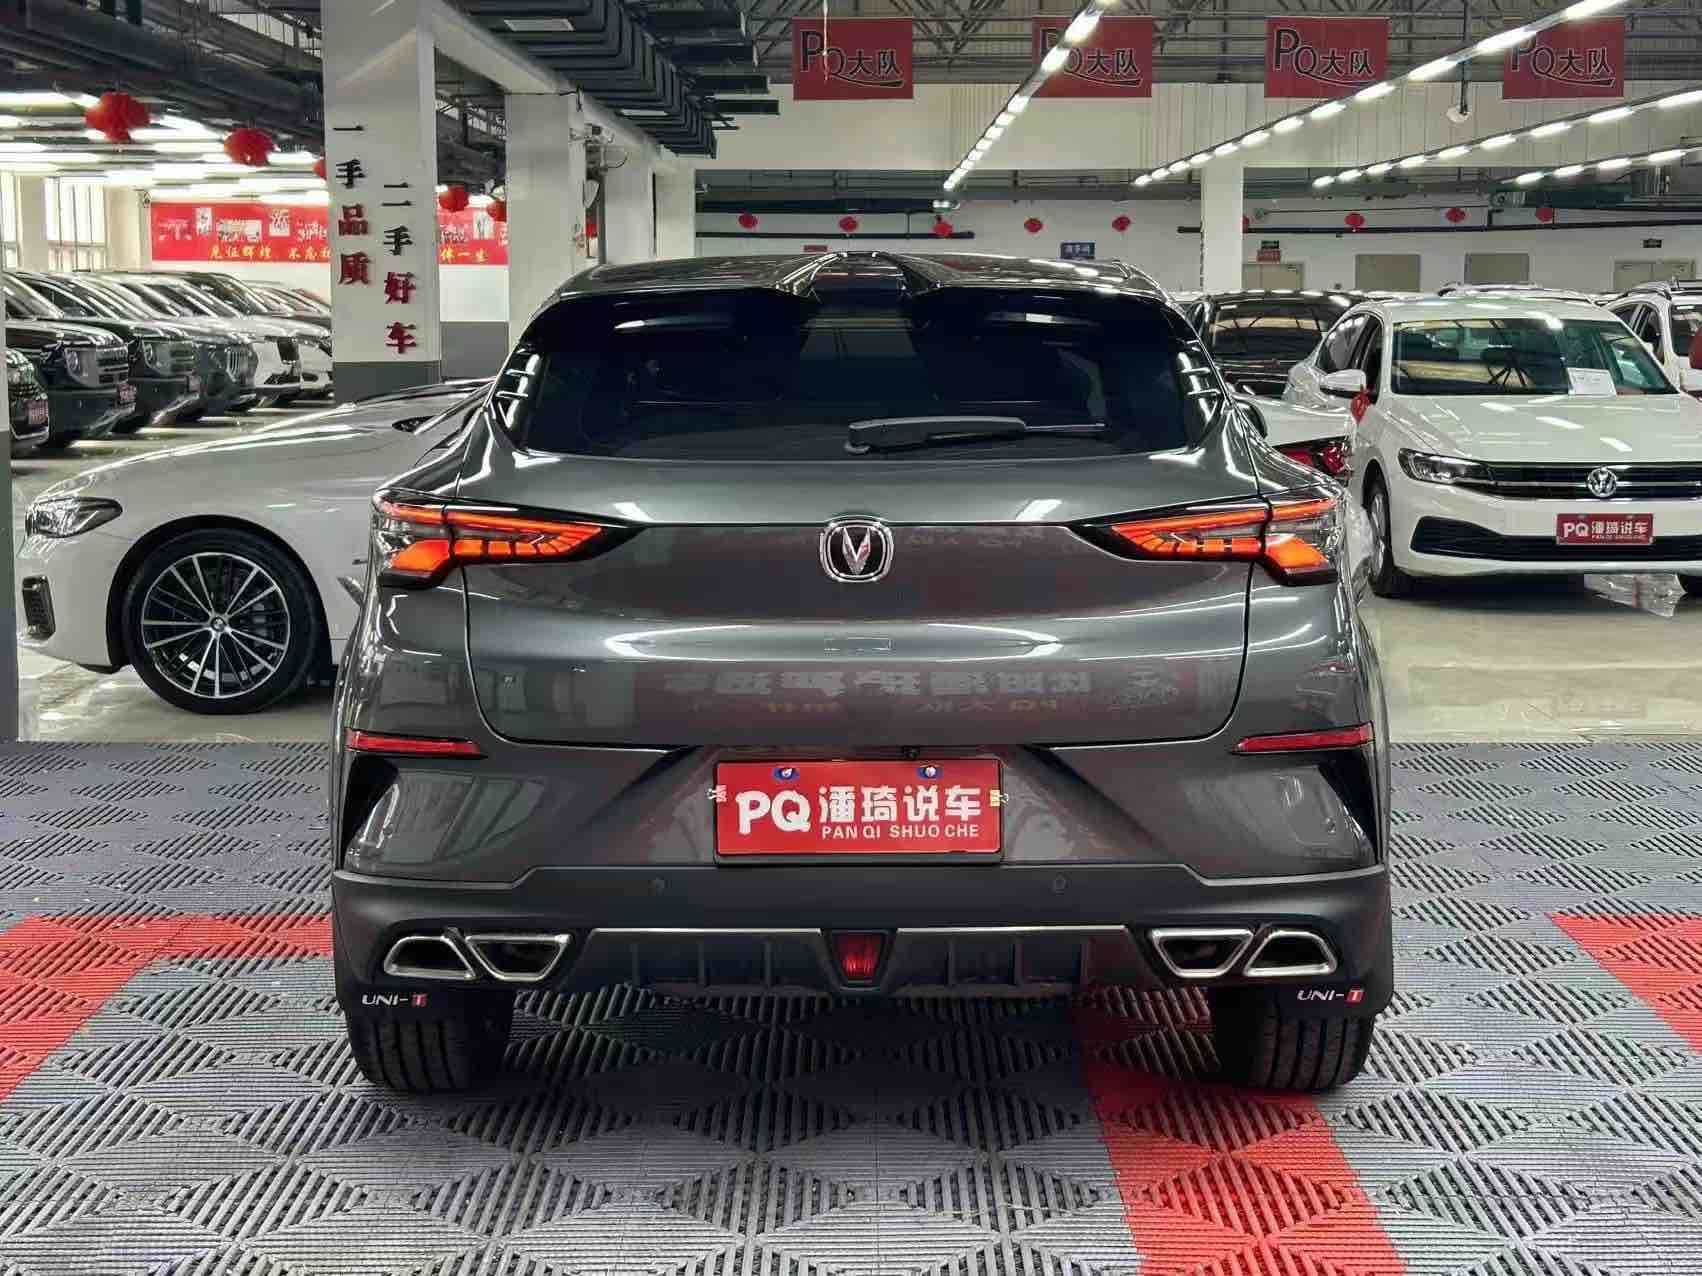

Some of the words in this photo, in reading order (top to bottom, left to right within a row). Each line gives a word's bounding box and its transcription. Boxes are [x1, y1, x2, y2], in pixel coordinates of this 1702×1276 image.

[332, 125, 371, 286] 一手品质
[381, 182, 418, 355] 二手好车
[821, 825, 858, 840] PAN
[862, 825, 881, 839] QI
[889, 824, 940, 839] SHUO
[944, 824, 980, 838] CHE
